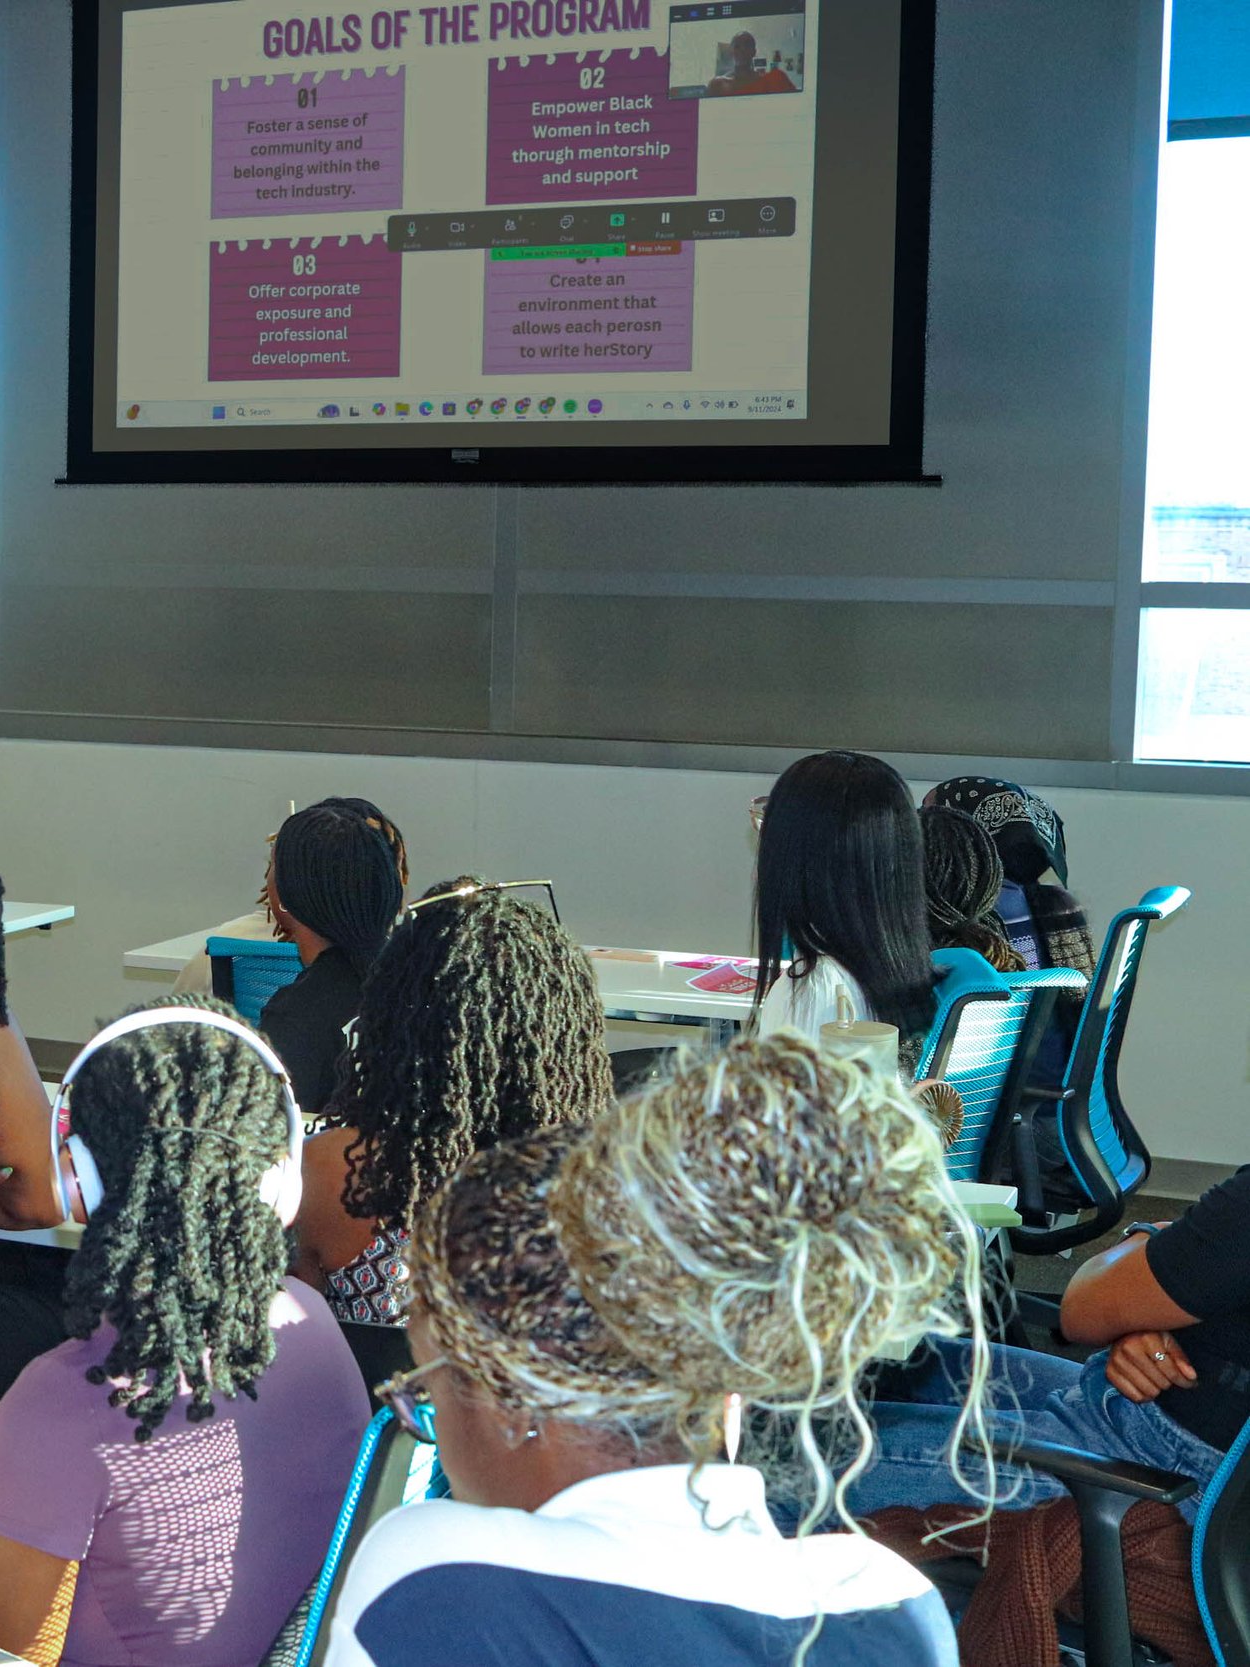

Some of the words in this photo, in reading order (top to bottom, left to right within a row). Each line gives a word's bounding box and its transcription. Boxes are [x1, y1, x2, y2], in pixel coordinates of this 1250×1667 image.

[263, 14, 362, 59] GOALS
[371, 10, 411, 50] OF
[419, 4, 479, 46] THE
[489, 0, 650, 41] PROGRAM
[579, 67, 605, 90] 02
[297, 87, 318, 109] 01
[531, 100, 605, 118] Empower
[609, 95, 653, 112] Black
[247, 117, 292, 135] Foster
[295, 120, 304, 132] a
[307, 116, 349, 131] sense
[352, 112, 369, 127] of
[532, 121, 591, 139] Women
[596, 121, 610, 135] in
[614, 118, 650, 134] tech
[250, 138, 332, 157] community
[335, 136, 363, 151] and
[511, 146, 574, 165] thorugh
[578, 141, 671, 161] mentorship
[233, 163, 304, 181] belonging
[307, 161, 352, 176] within
[355, 158, 380, 172] the
[542, 169, 571, 185] and
[575, 167, 639, 187] support
[256, 185, 288, 200] tech
[291, 183, 356, 199] industry.
[292, 254, 317, 276] 03
[549, 274, 602, 288] Create
[606, 273, 625, 286] an
[248, 284, 286, 299] Offer
[289, 282, 361, 300] corporate
[518, 297, 620, 312] environment
[623, 295, 657, 310] that
[255, 306, 322, 324] exposure
[325, 304, 352, 319] and
[259, 326, 348, 346] professional
[512, 320, 562, 336] allows
[565, 319, 602, 335] each
[606, 320, 662, 336] perosn
[252, 350, 351, 367] development.
[520, 345, 536, 359] to
[539, 343, 582, 359] write
[584, 342, 653, 361] herStory
[250, 408, 271, 417] Search
